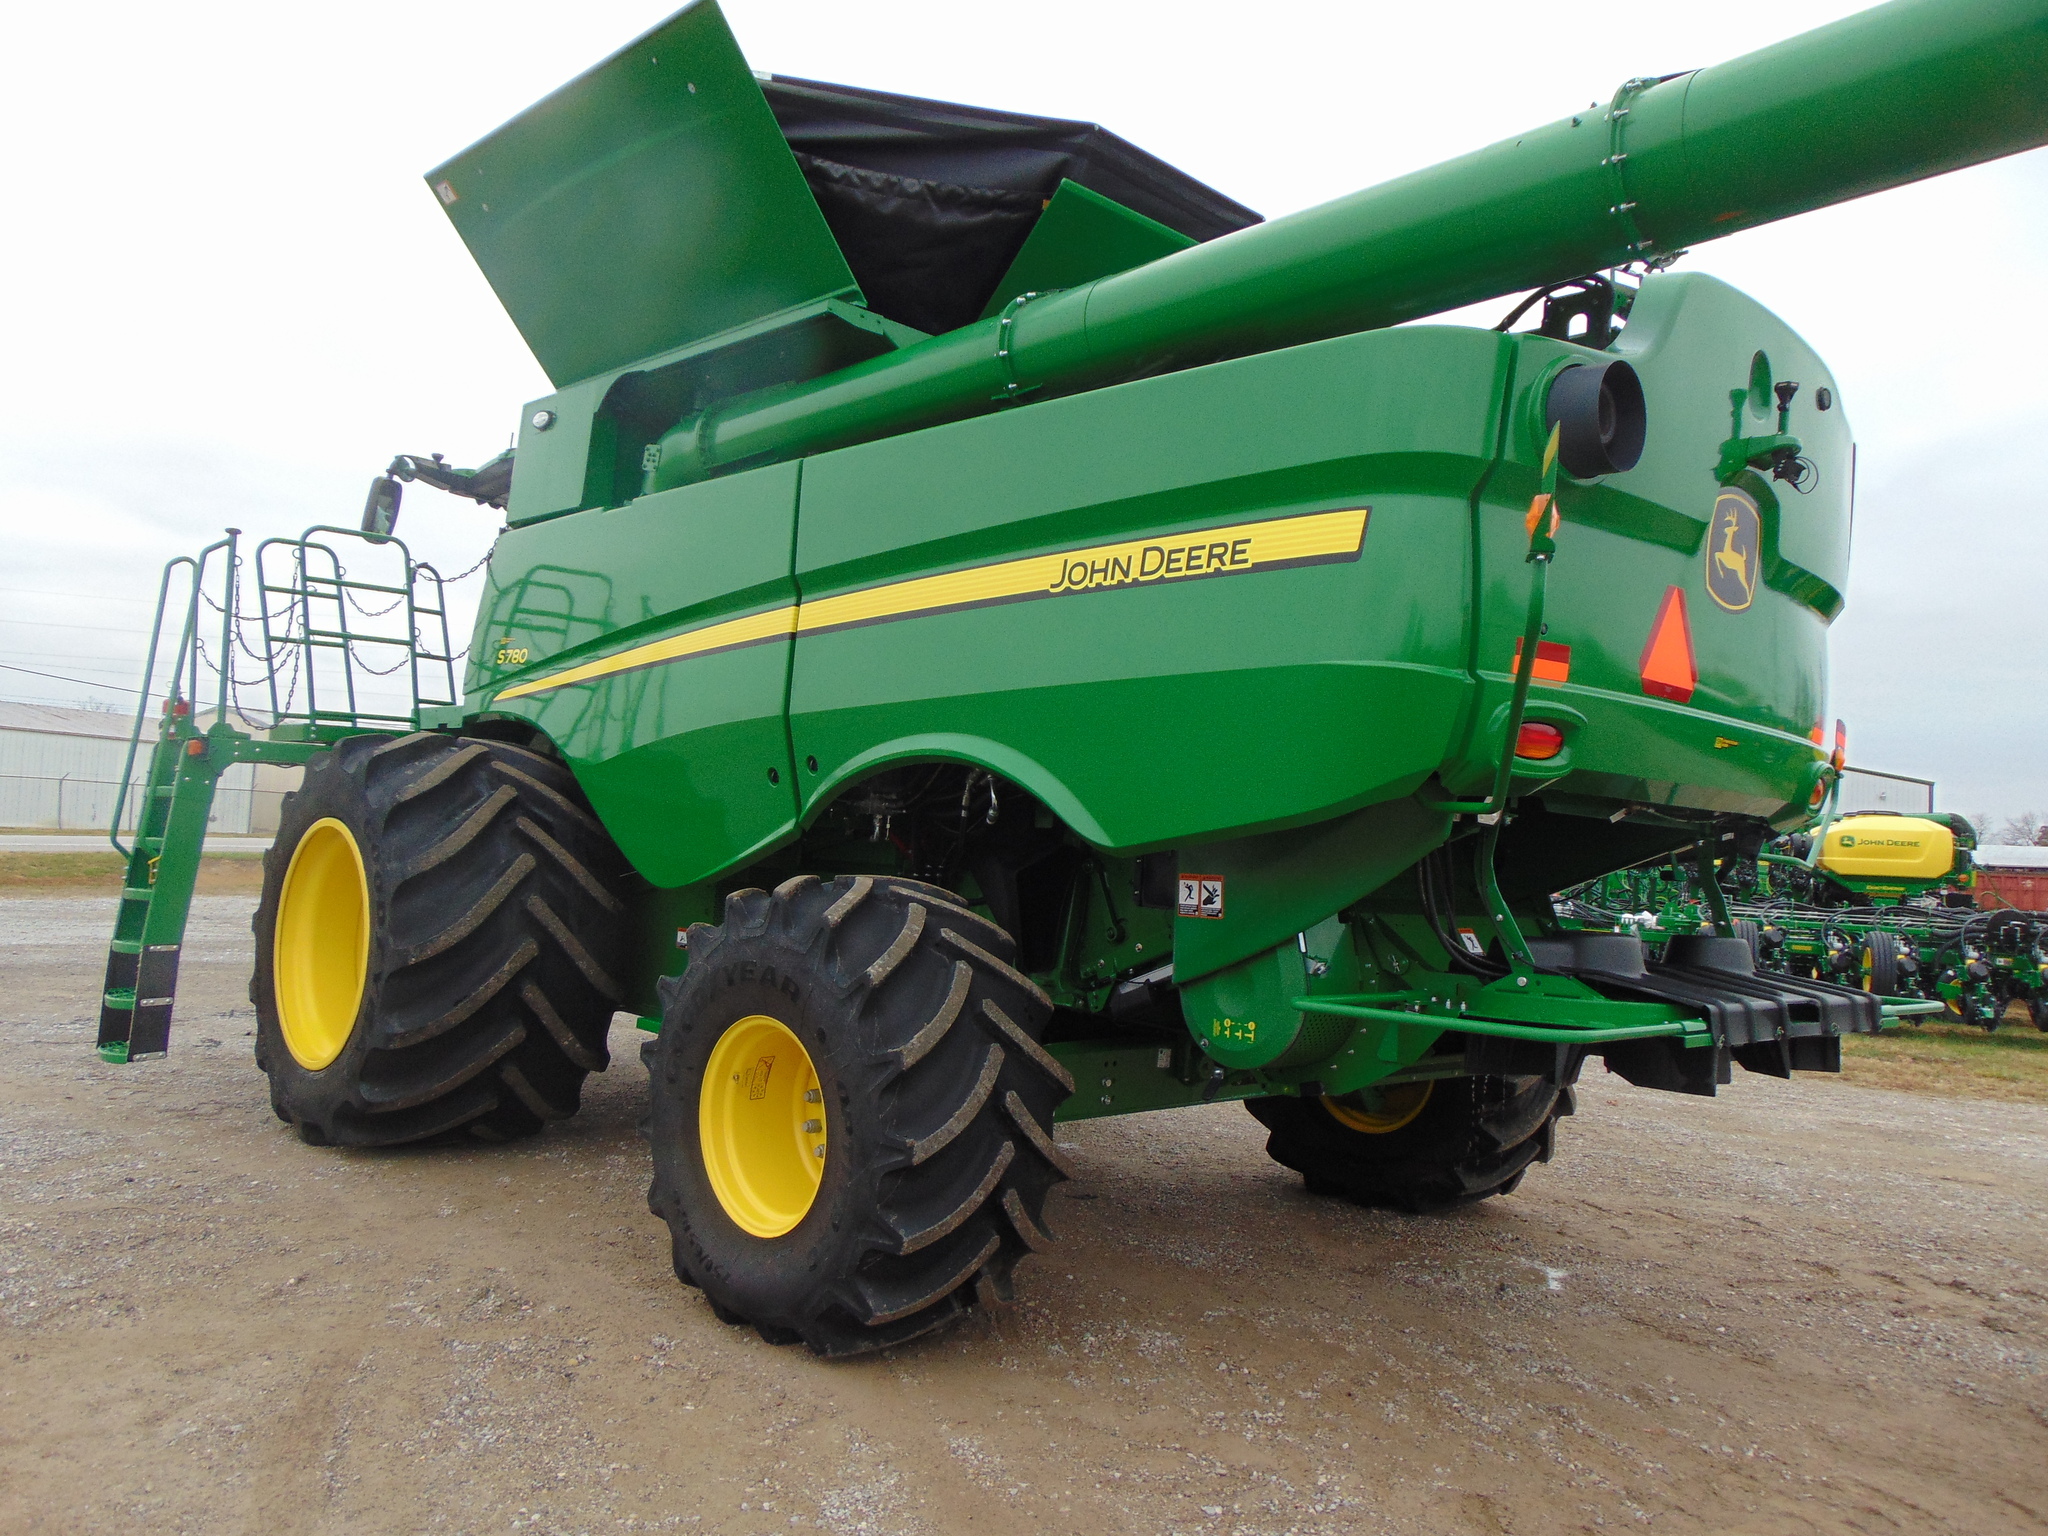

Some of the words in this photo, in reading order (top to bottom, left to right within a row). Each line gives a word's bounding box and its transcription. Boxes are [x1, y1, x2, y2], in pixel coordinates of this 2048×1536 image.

[1050, 555, 1132, 589] JOHN
[1139, 539, 1252, 577] DEERE
[497, 648, 528, 664] S780
[1858, 838, 1884, 846] JOHN
[1886, 839, 1920, 847] DEERE
